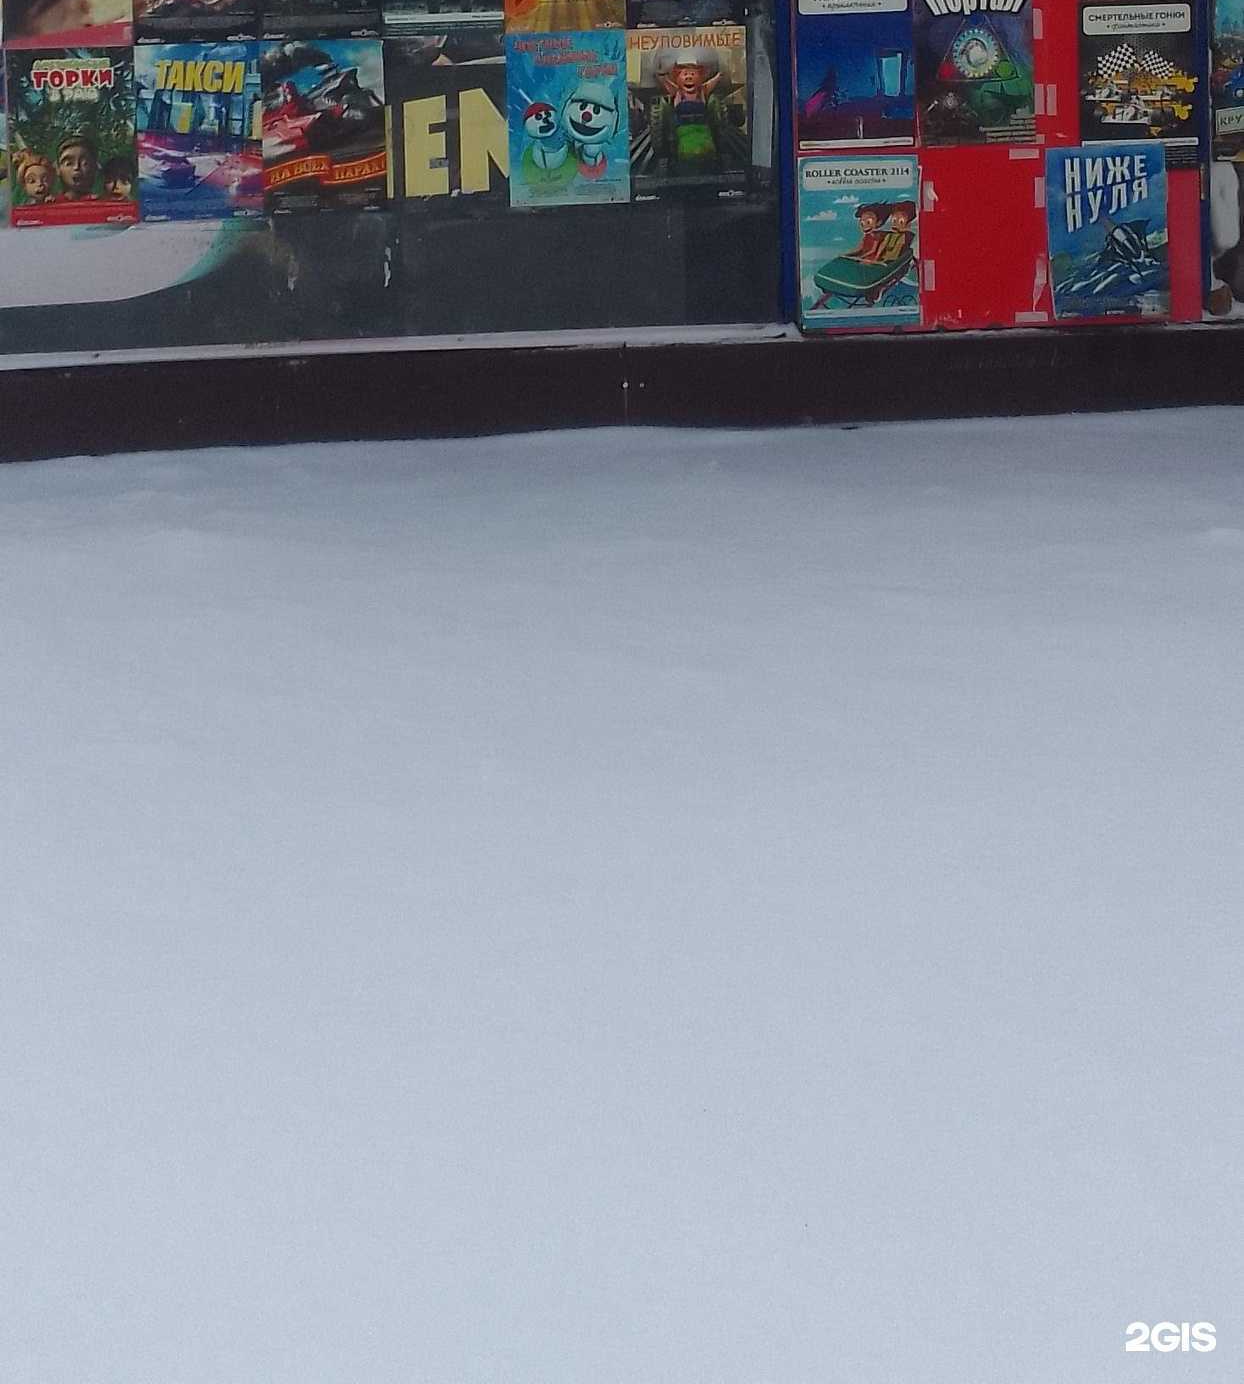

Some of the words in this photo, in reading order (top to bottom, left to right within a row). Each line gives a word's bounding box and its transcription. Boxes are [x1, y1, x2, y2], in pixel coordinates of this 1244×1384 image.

[1088, 11, 1153, 22] СМЕРТЕЛЬНЫЕ
[1155, 11, 1185, 21] ГОНКИ
[629, 31, 742, 51] НЕУЛОВИМЫЕ
[154, 59, 246, 94] ТАКСИ
[805, 168, 841, 178] ROLLER
[843, 168, 888, 177] COASTER
[1064, 155, 1148, 192] НИЖЕ
[1066, 177, 1148, 233] НУЛЯ
